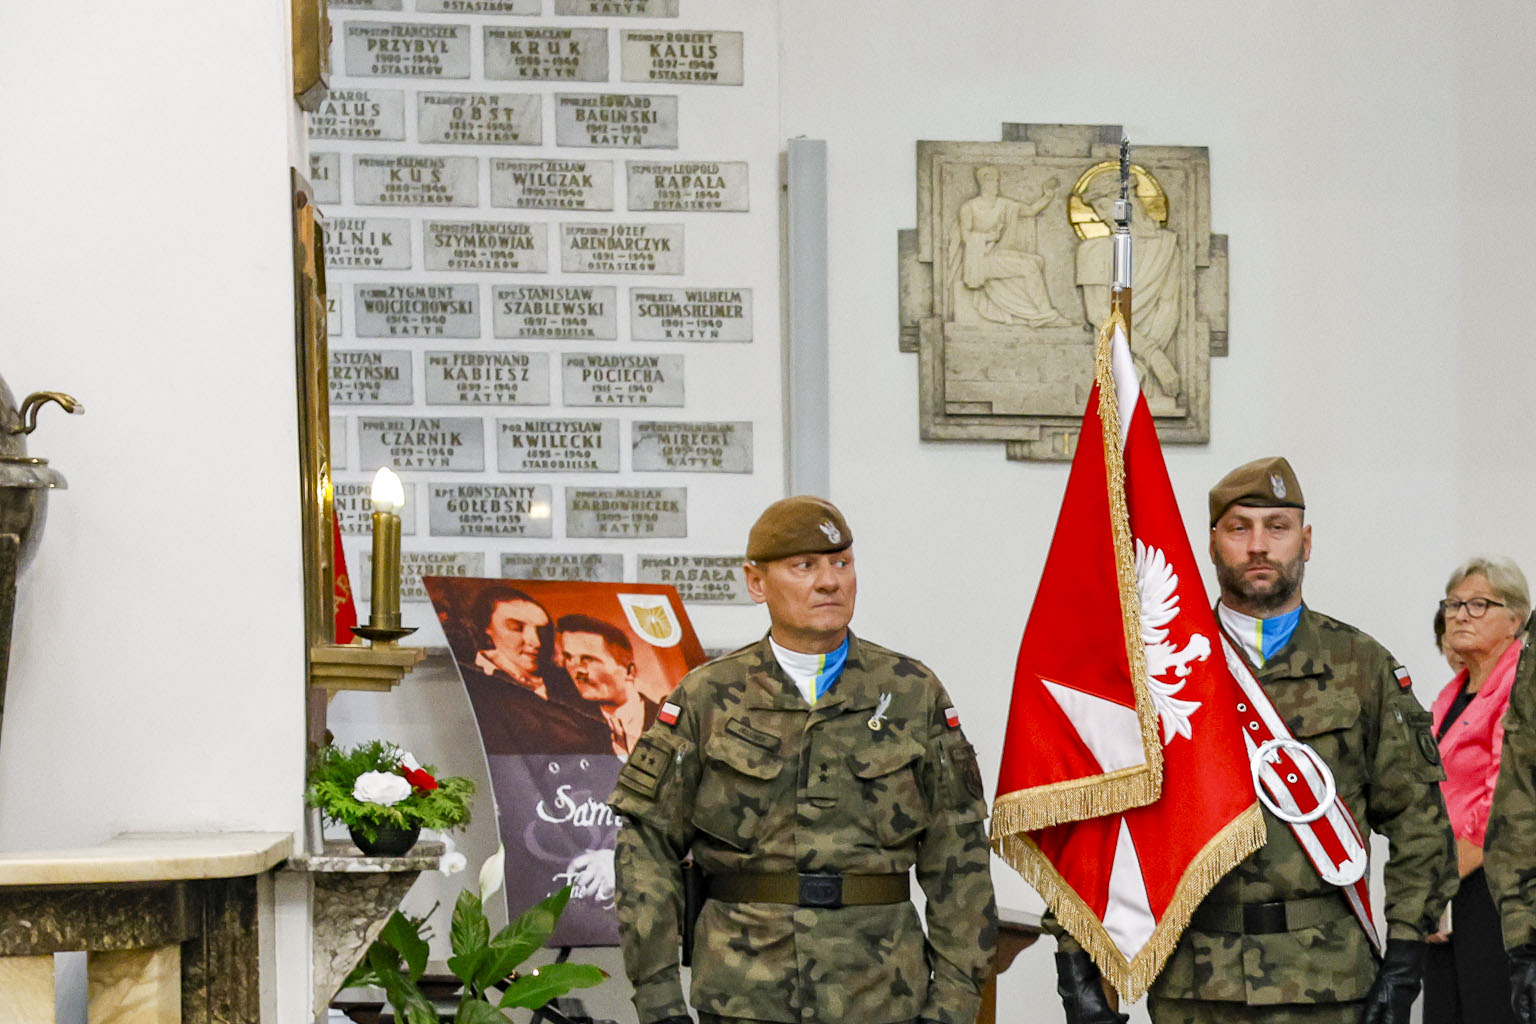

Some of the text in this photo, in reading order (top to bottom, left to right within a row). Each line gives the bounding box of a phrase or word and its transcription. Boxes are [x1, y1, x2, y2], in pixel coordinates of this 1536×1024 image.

[367, 38, 449, 53] PRZYBYŁ
[510, 41, 581, 56] KRUK
[649, 44, 718, 59] KALUS
[452, 106, 513, 121] OBST
[512, 173, 593, 188] WILCZAK
[434, 234, 534, 250] SZYMKOWIAK
[503, 301, 603, 316] SZABLEWSKI
[453, 354, 529, 367] FERDYNAND
[443, 367, 529, 382] KABIESZ
[582, 369, 665, 383] POCIECHA
[410, 418, 441, 432] JAN
[380, 432, 463, 446] CZARNIK
[512, 434, 602, 449] KWILECKI
[458, 486, 535, 499] KONSTANTY
